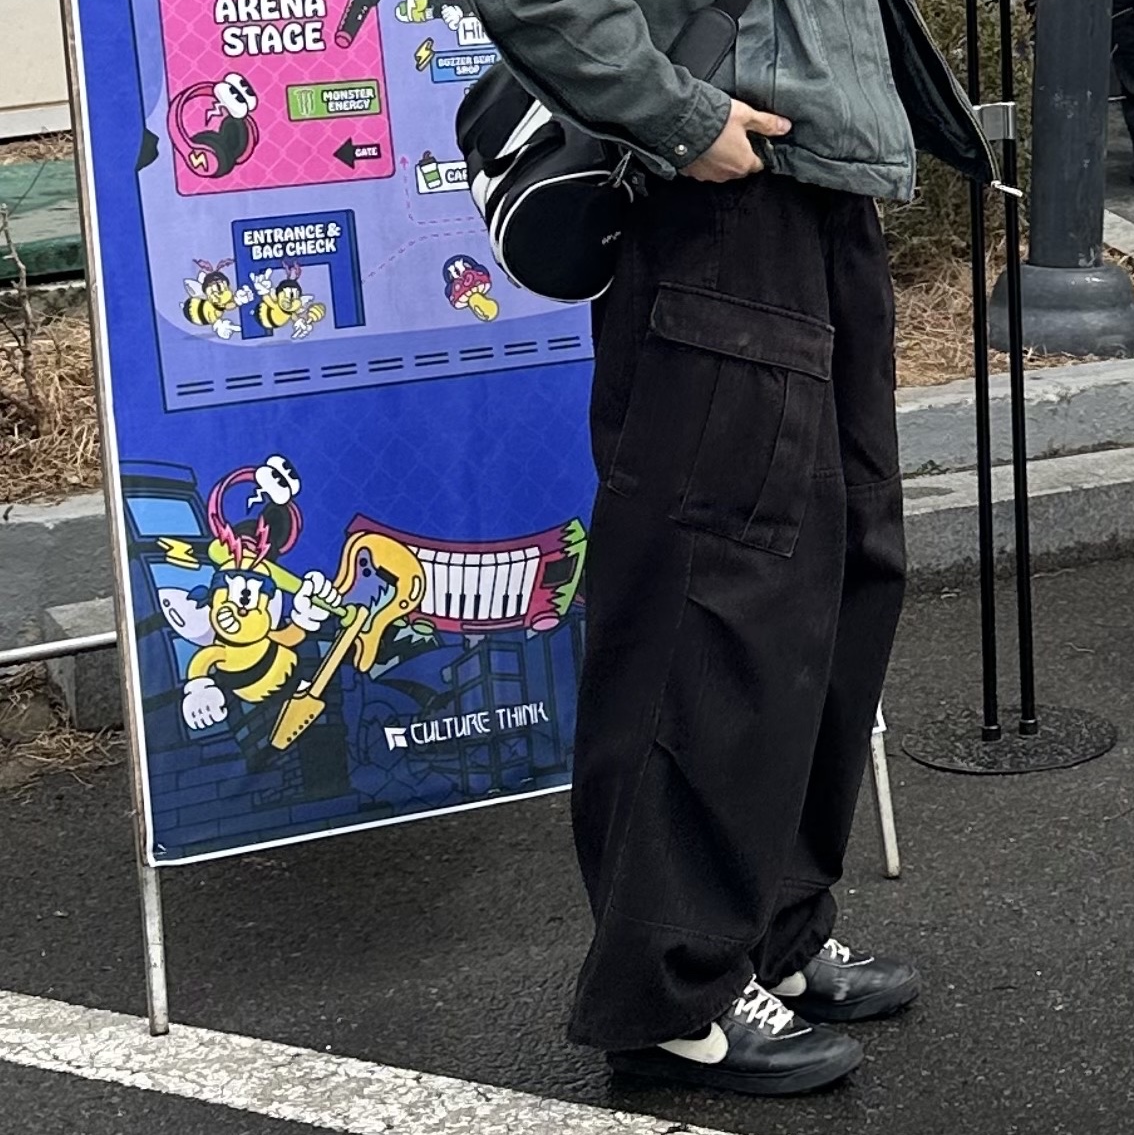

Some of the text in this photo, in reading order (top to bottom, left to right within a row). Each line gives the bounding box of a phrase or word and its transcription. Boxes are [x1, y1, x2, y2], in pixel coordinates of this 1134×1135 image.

[222, 21, 326, 56] STAGE
[322, 88, 375, 101] MONSTER
[327, 99, 371, 112] ENERGY
[355, 146, 378, 158] GATE
[243, 222, 341, 246] ENTRANCE &
[251, 237, 337, 260] BAG CHECK
[409, 701, 549, 744] CULTURE THINK
